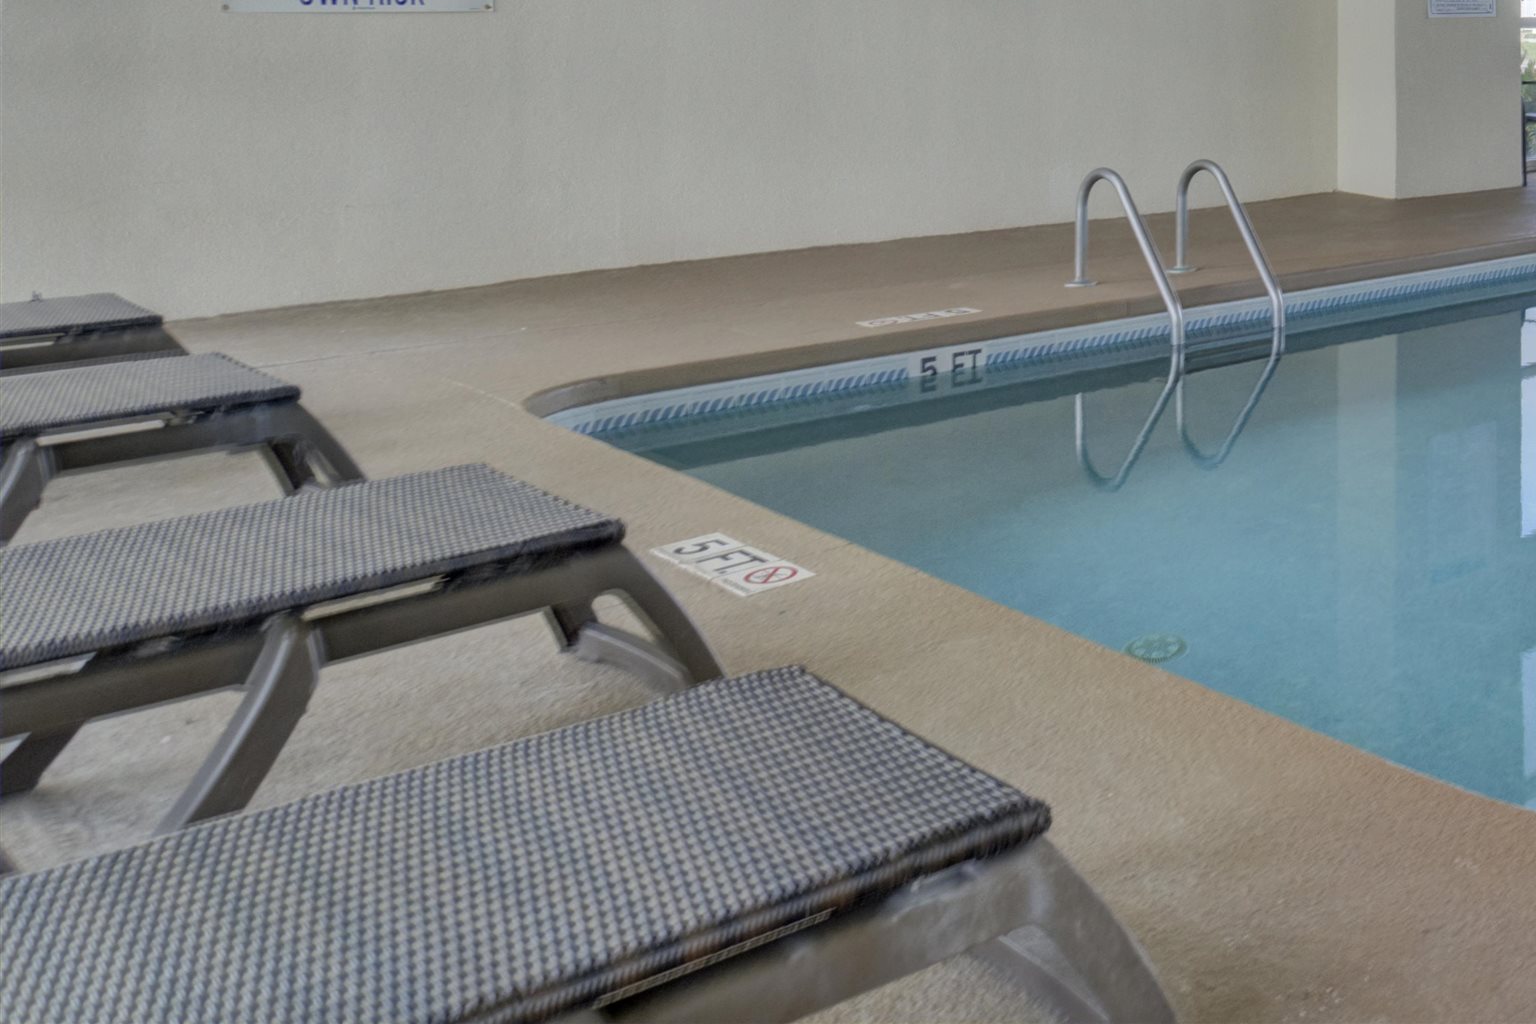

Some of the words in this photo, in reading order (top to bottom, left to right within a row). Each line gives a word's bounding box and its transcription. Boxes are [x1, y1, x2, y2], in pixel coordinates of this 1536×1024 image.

[920, 355, 938, 376] 5
[952, 348, 982, 373] FT
[673, 538, 729, 555] 5
